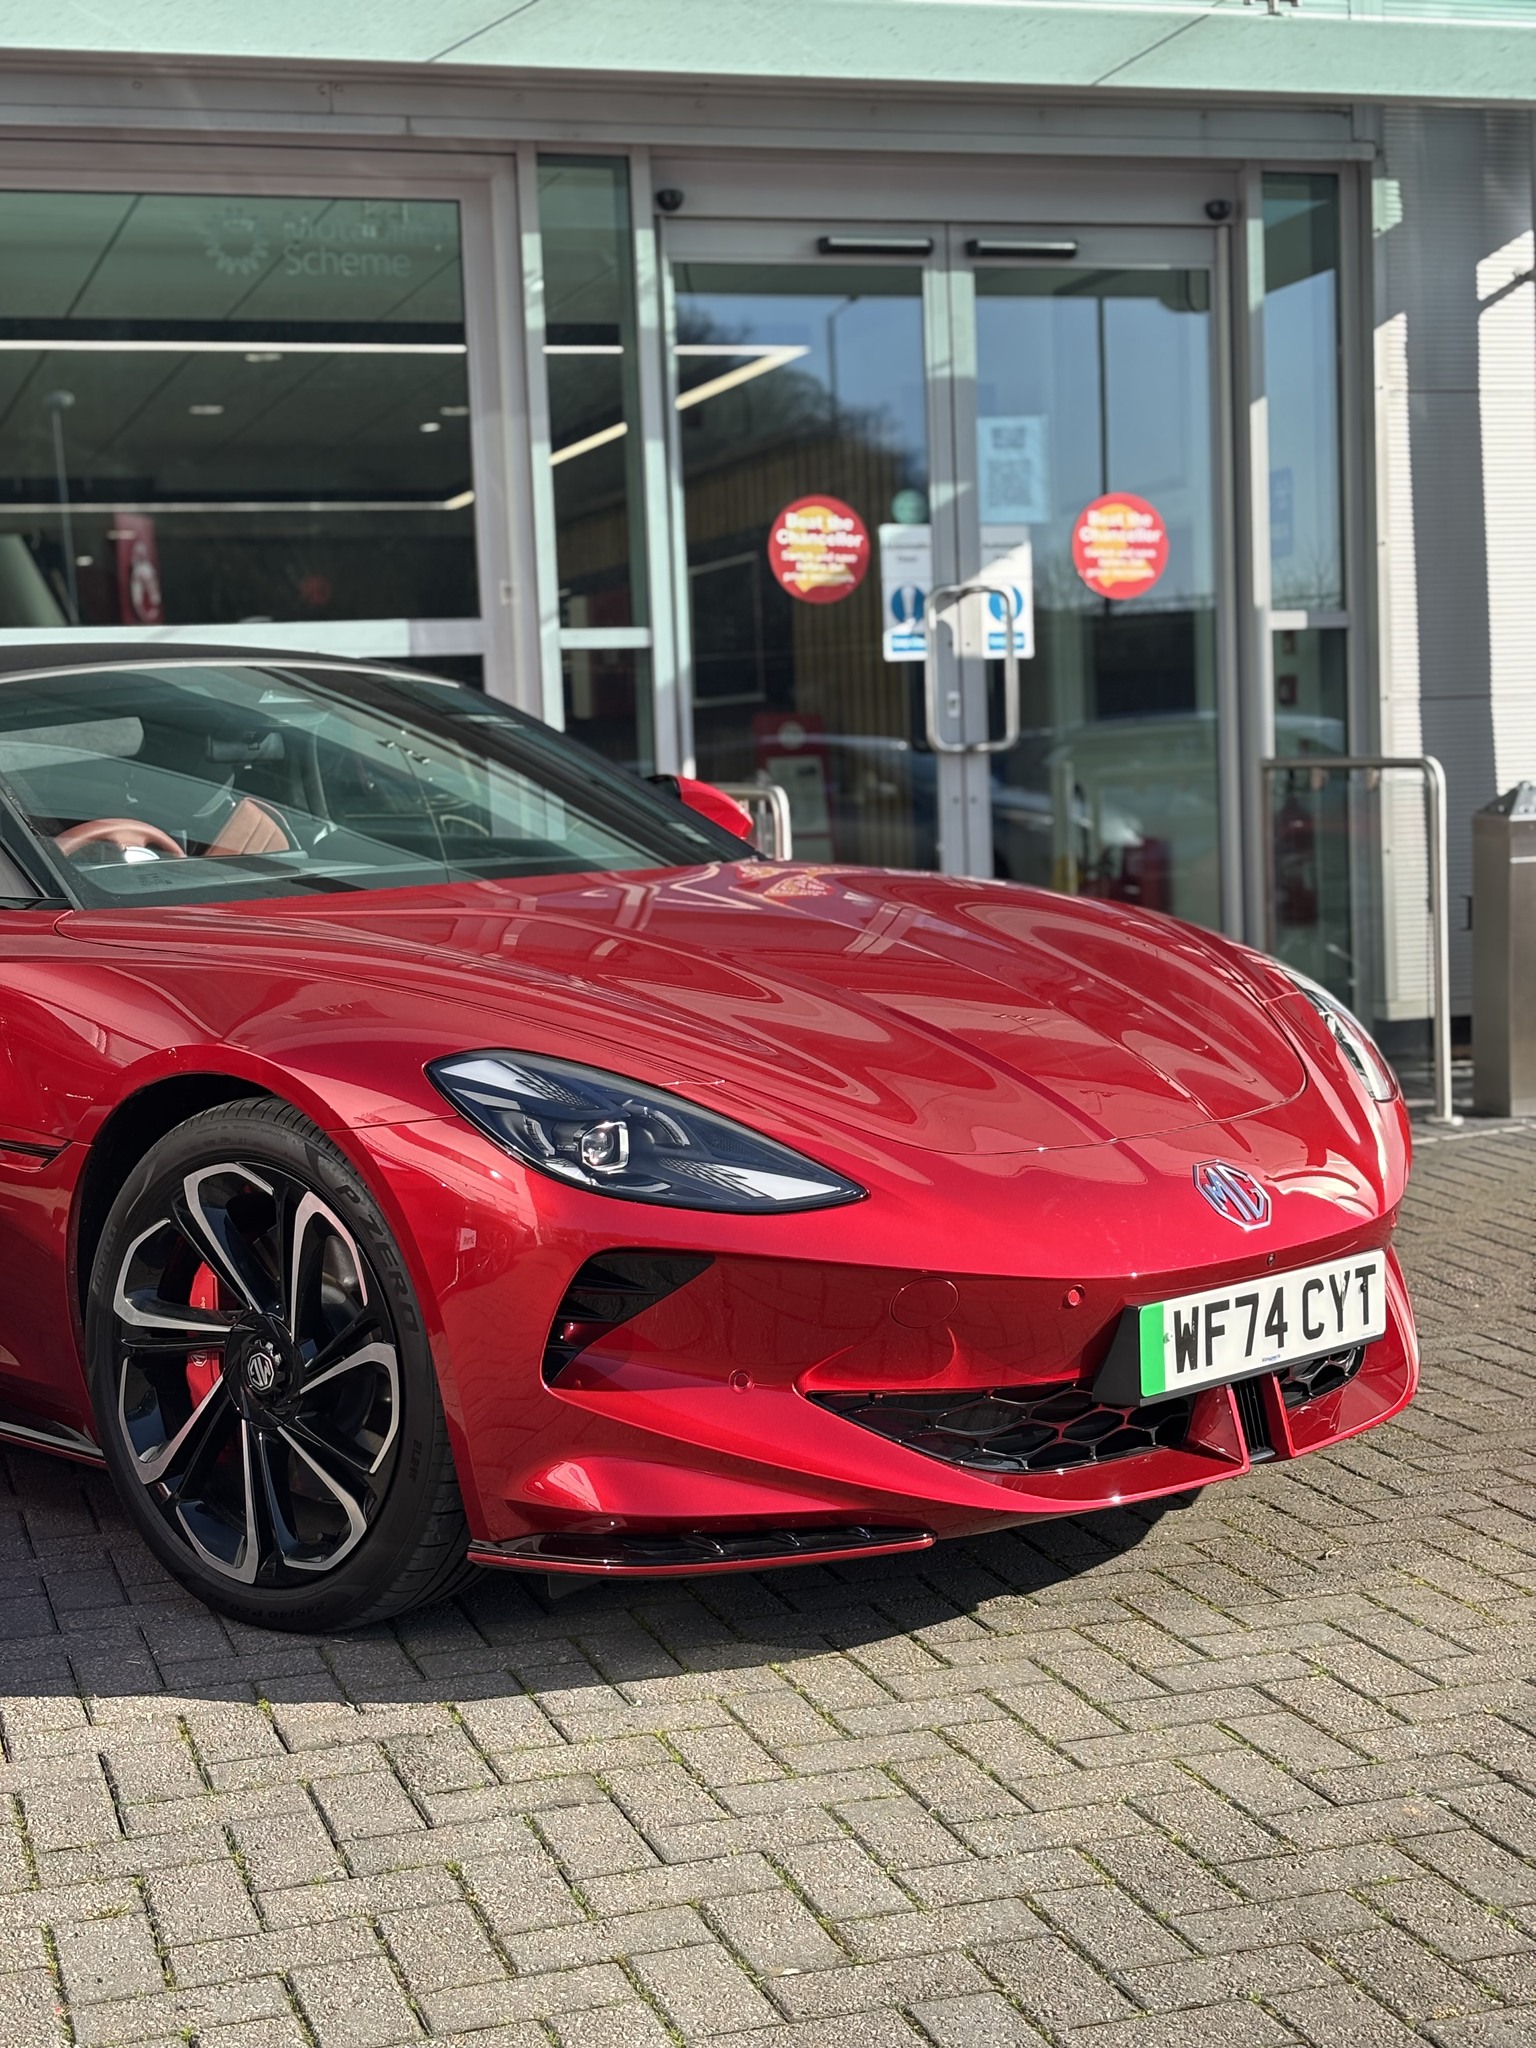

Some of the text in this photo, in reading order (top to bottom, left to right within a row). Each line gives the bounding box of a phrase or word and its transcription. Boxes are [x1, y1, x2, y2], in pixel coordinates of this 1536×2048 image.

[284, 244, 411, 277] Scheme
[785, 512, 854, 532] Beat the
[1087, 510, 1153, 528] Beat the
[775, 528, 864, 548] Chancellor
[1079, 526, 1162, 544] Chancellor
[1199, 1163, 1268, 1225] MG
[335, 1184, 419, 1333] P ZERO
[1173, 1264, 1377, 1374] WF74 CYT
